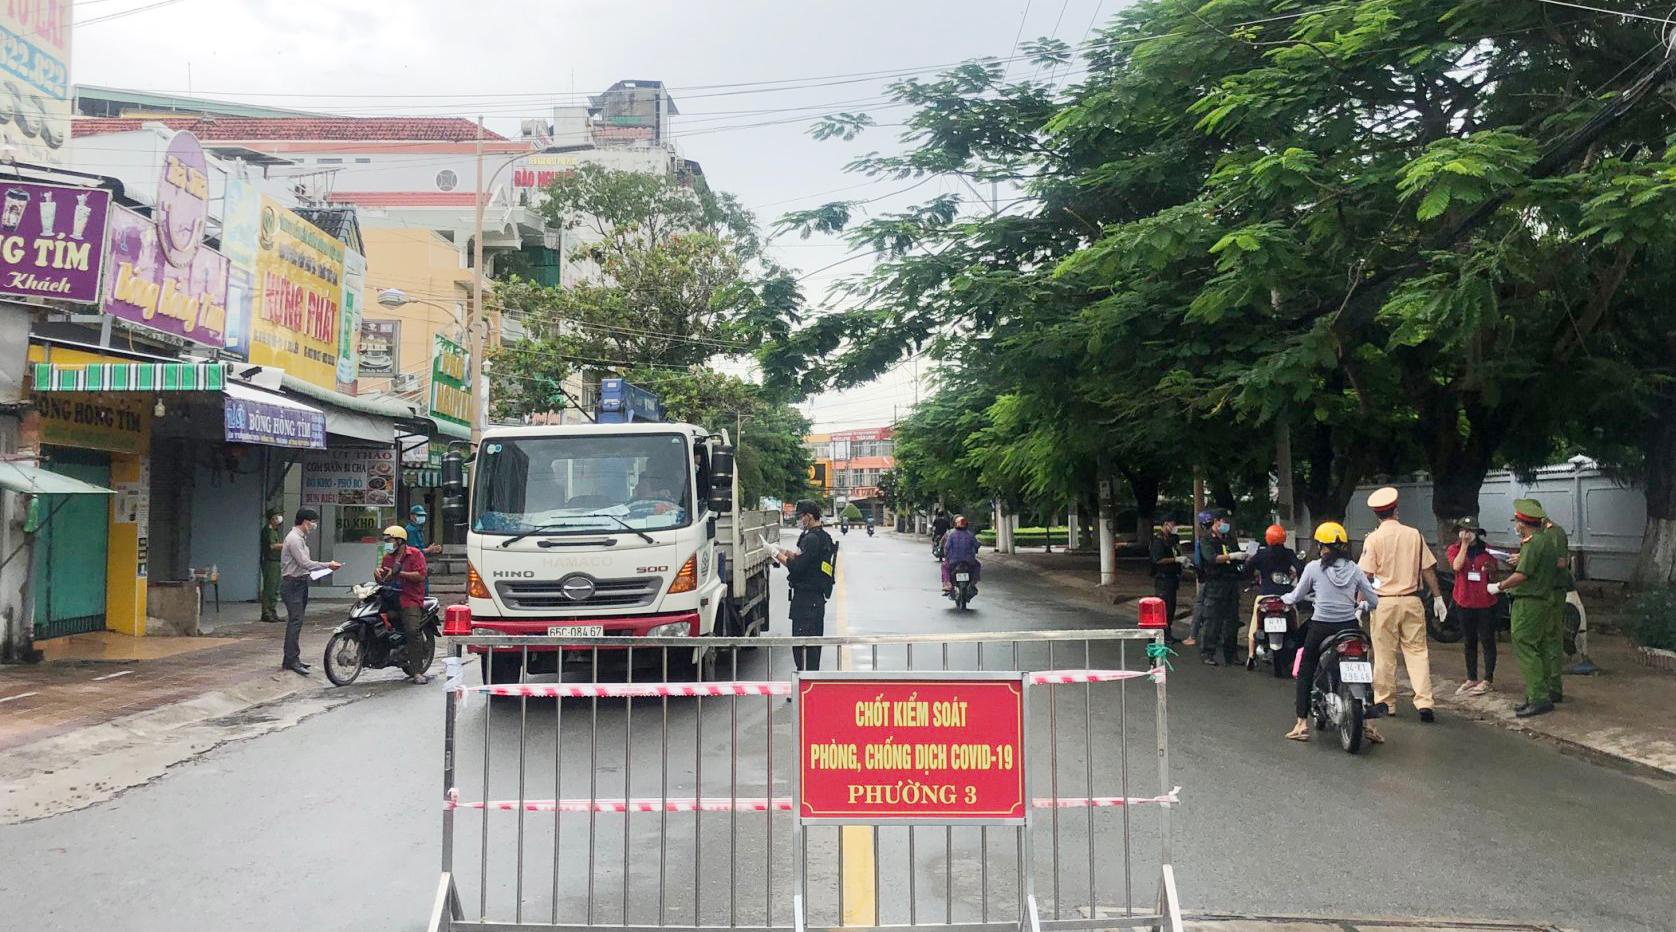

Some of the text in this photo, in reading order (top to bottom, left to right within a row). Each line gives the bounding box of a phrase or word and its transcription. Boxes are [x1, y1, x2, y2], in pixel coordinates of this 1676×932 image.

[34, 232, 91, 271] TÍM
[3, 271, 72, 293] Khách
[248, 409, 272, 433] BÔNG
[855, 692, 967, 727] CHỐT KIỂM SOÁT
[811, 736, 1013, 775] PHÒNG, CHỐNG DỊCH COVID-19
[848, 779, 977, 804] PHƯỜNG 3
